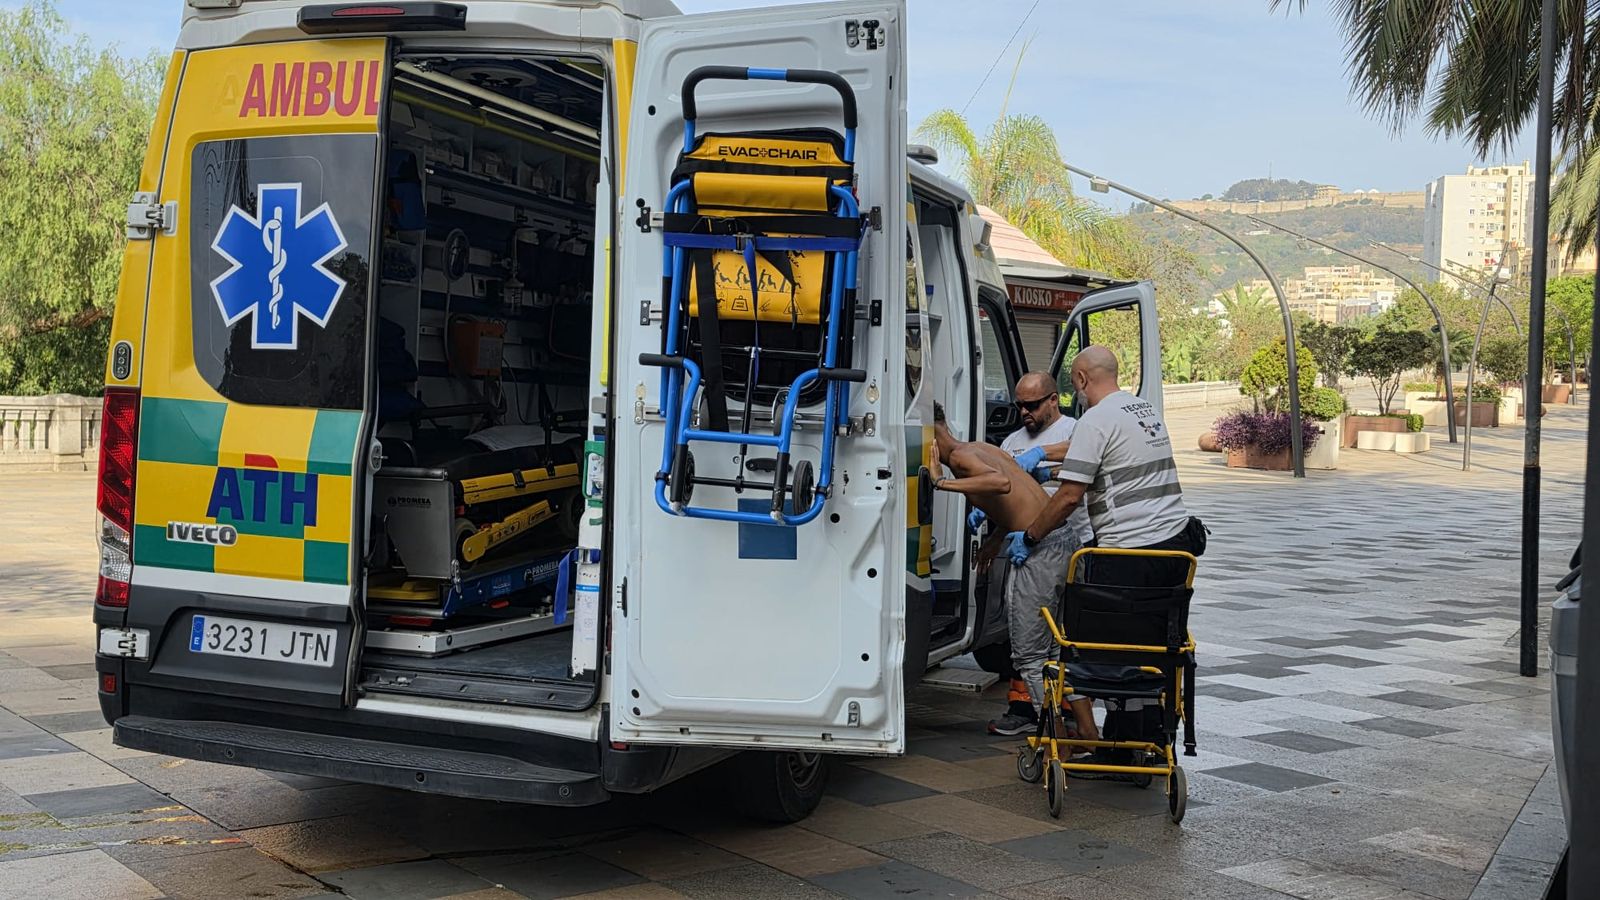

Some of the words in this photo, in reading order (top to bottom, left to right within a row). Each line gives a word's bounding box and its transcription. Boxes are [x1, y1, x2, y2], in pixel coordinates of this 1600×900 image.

[239, 61, 379, 117] AMBUL
[1014, 287, 1052, 306] KIOSKO
[206, 466, 318, 527] ATH
[167, 522, 237, 545] IVECO
[193, 637, 200, 645] E
[208, 623, 267, 655] 3231
[280, 631, 331, 662] JTN
